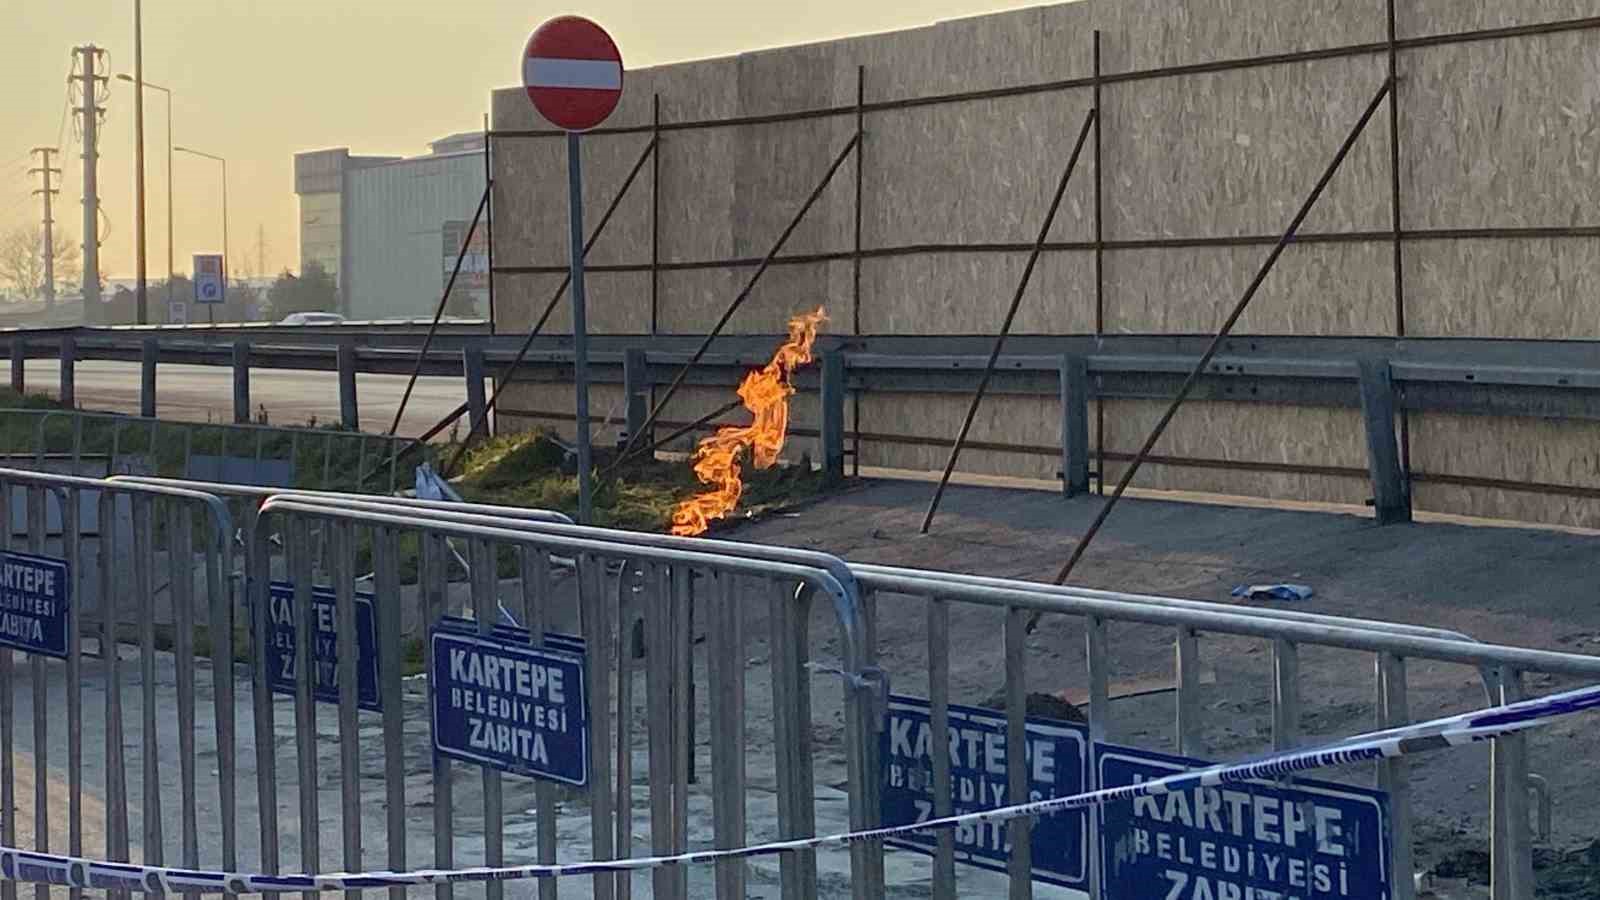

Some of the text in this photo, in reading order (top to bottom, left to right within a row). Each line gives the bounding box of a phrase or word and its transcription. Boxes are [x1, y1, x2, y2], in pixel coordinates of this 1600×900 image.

[450, 648, 565, 704] KARTEPE
[452, 687, 567, 733] BELEDİYESİ
[469, 717, 549, 765] ZABITA
[890, 716, 1056, 783] KARTEE
[1133, 773, 1345, 856] KARTEPE
[1134, 828, 1349, 896] BELEDİYESİ
